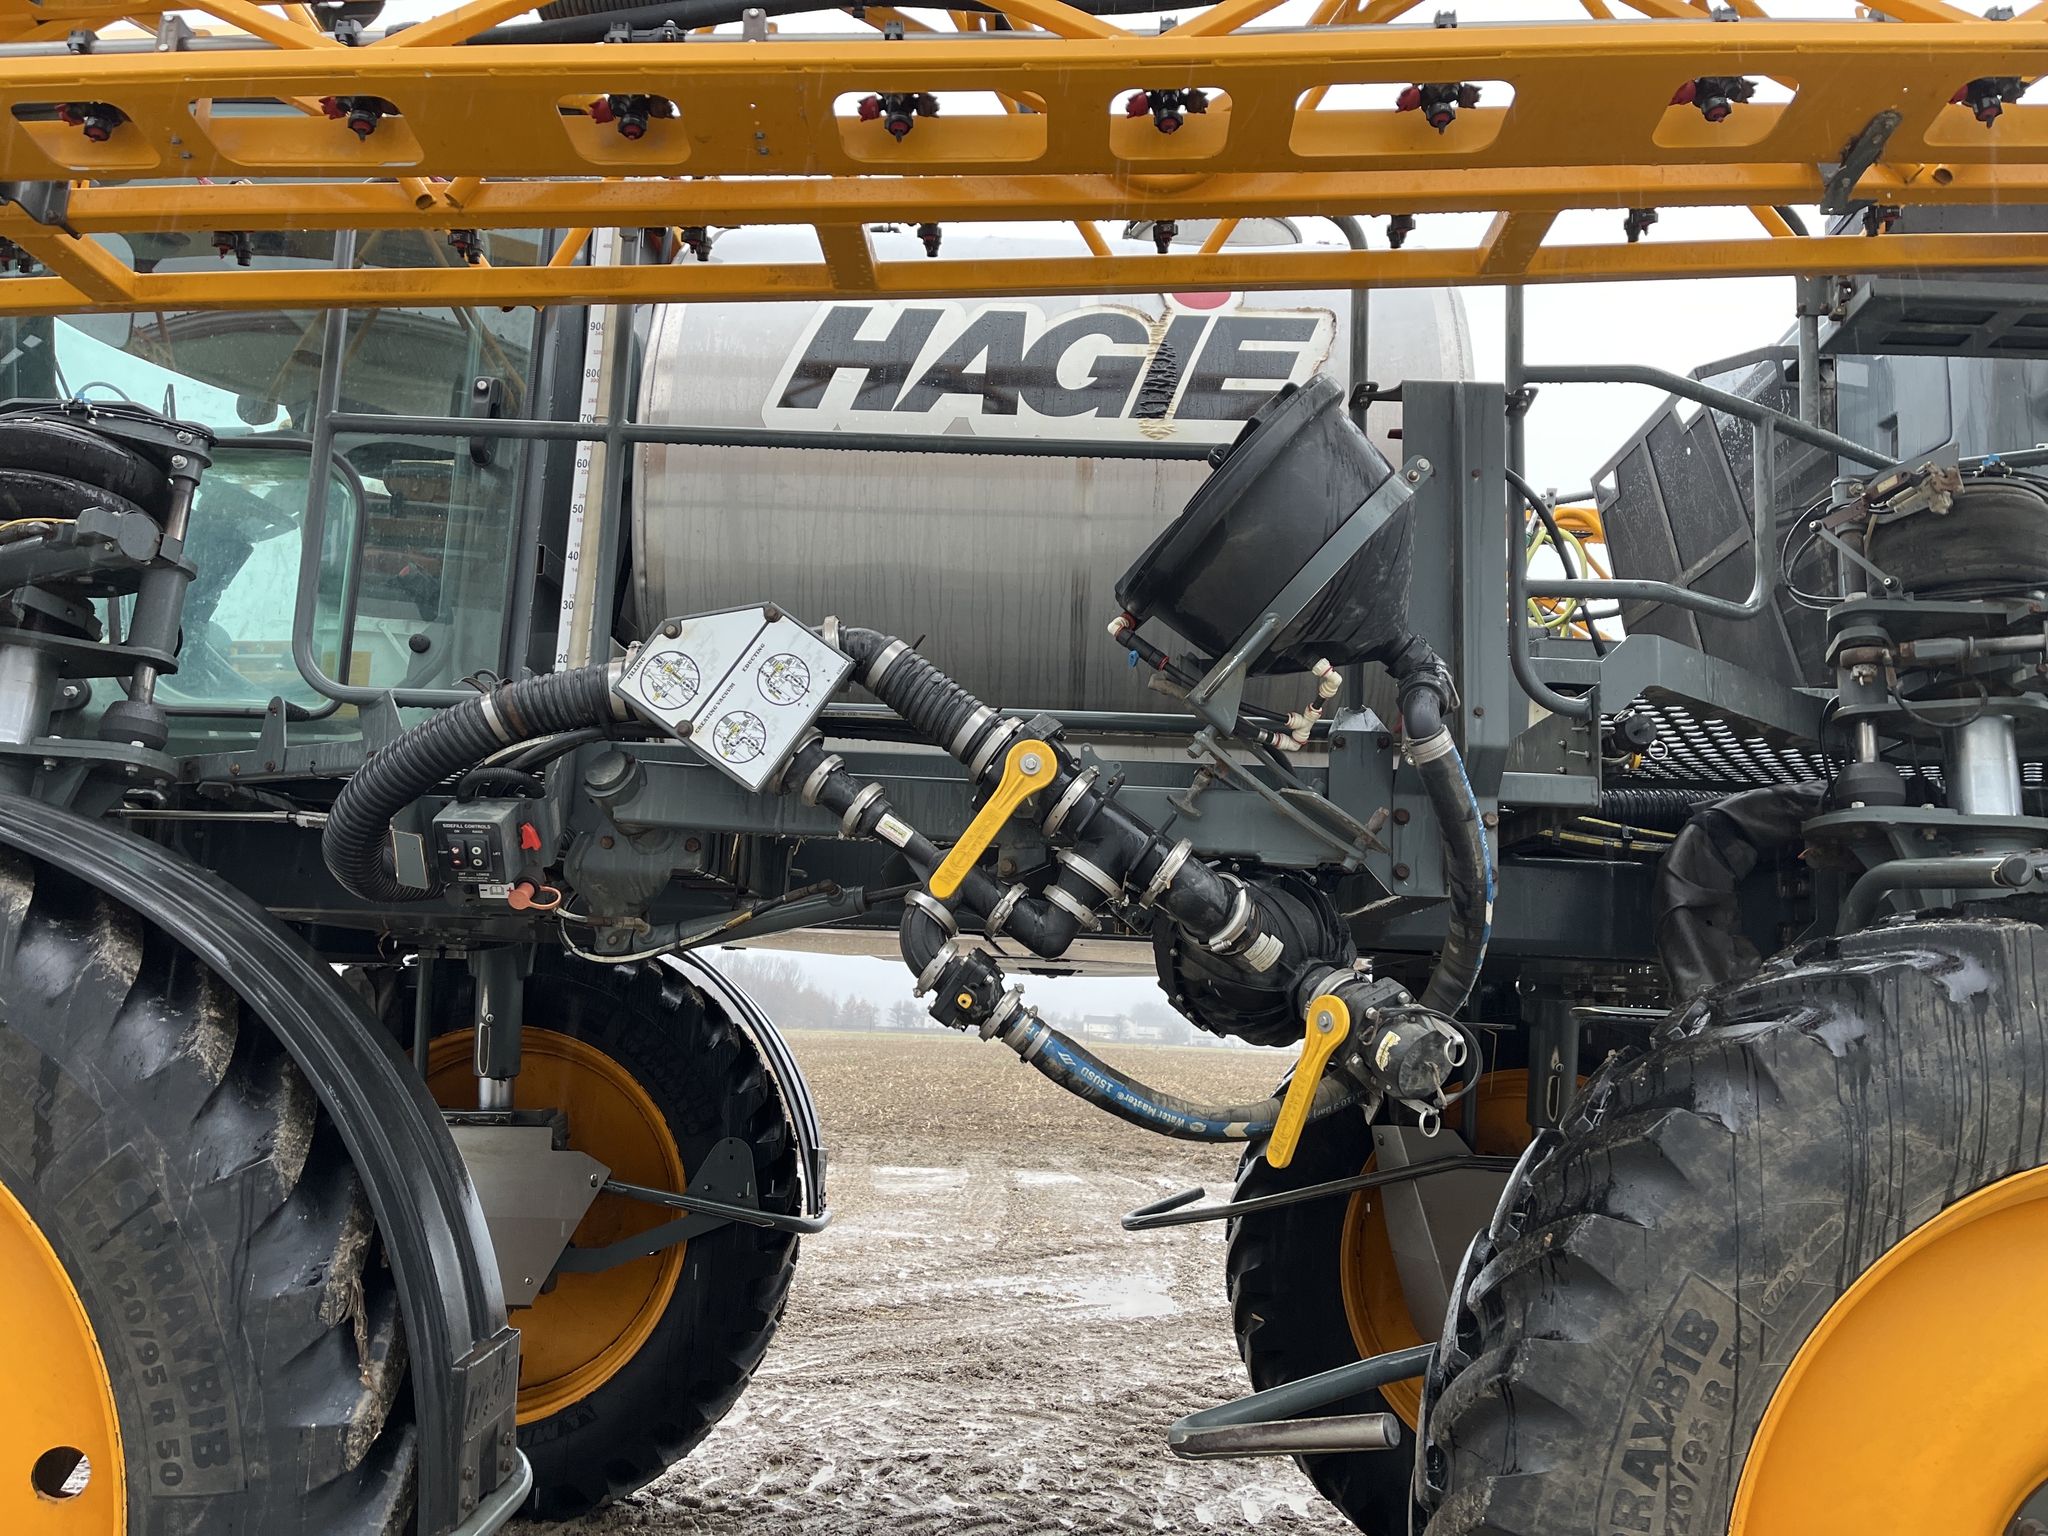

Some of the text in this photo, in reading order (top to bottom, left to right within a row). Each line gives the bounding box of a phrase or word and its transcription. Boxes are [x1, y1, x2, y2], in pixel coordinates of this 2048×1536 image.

[777, 292, 1321, 420] HAGIE
[581, 414, 592, 423] 70
[627, 656, 646, 680] FILLING
[741, 642, 766, 672] EDUCTING
[694, 682, 736, 734] CREATING VACUUM
[1080, 1066, 1114, 1093] 15USD
[1157, 1111, 1186, 1128] Water
[116, 1179, 231, 1470] SPRAYBIB
[1609, 1308, 1720, 1536] RAYBIB
[155, 1437, 184, 1488] 50
[1664, 1416, 1715, 1536] 20/95
